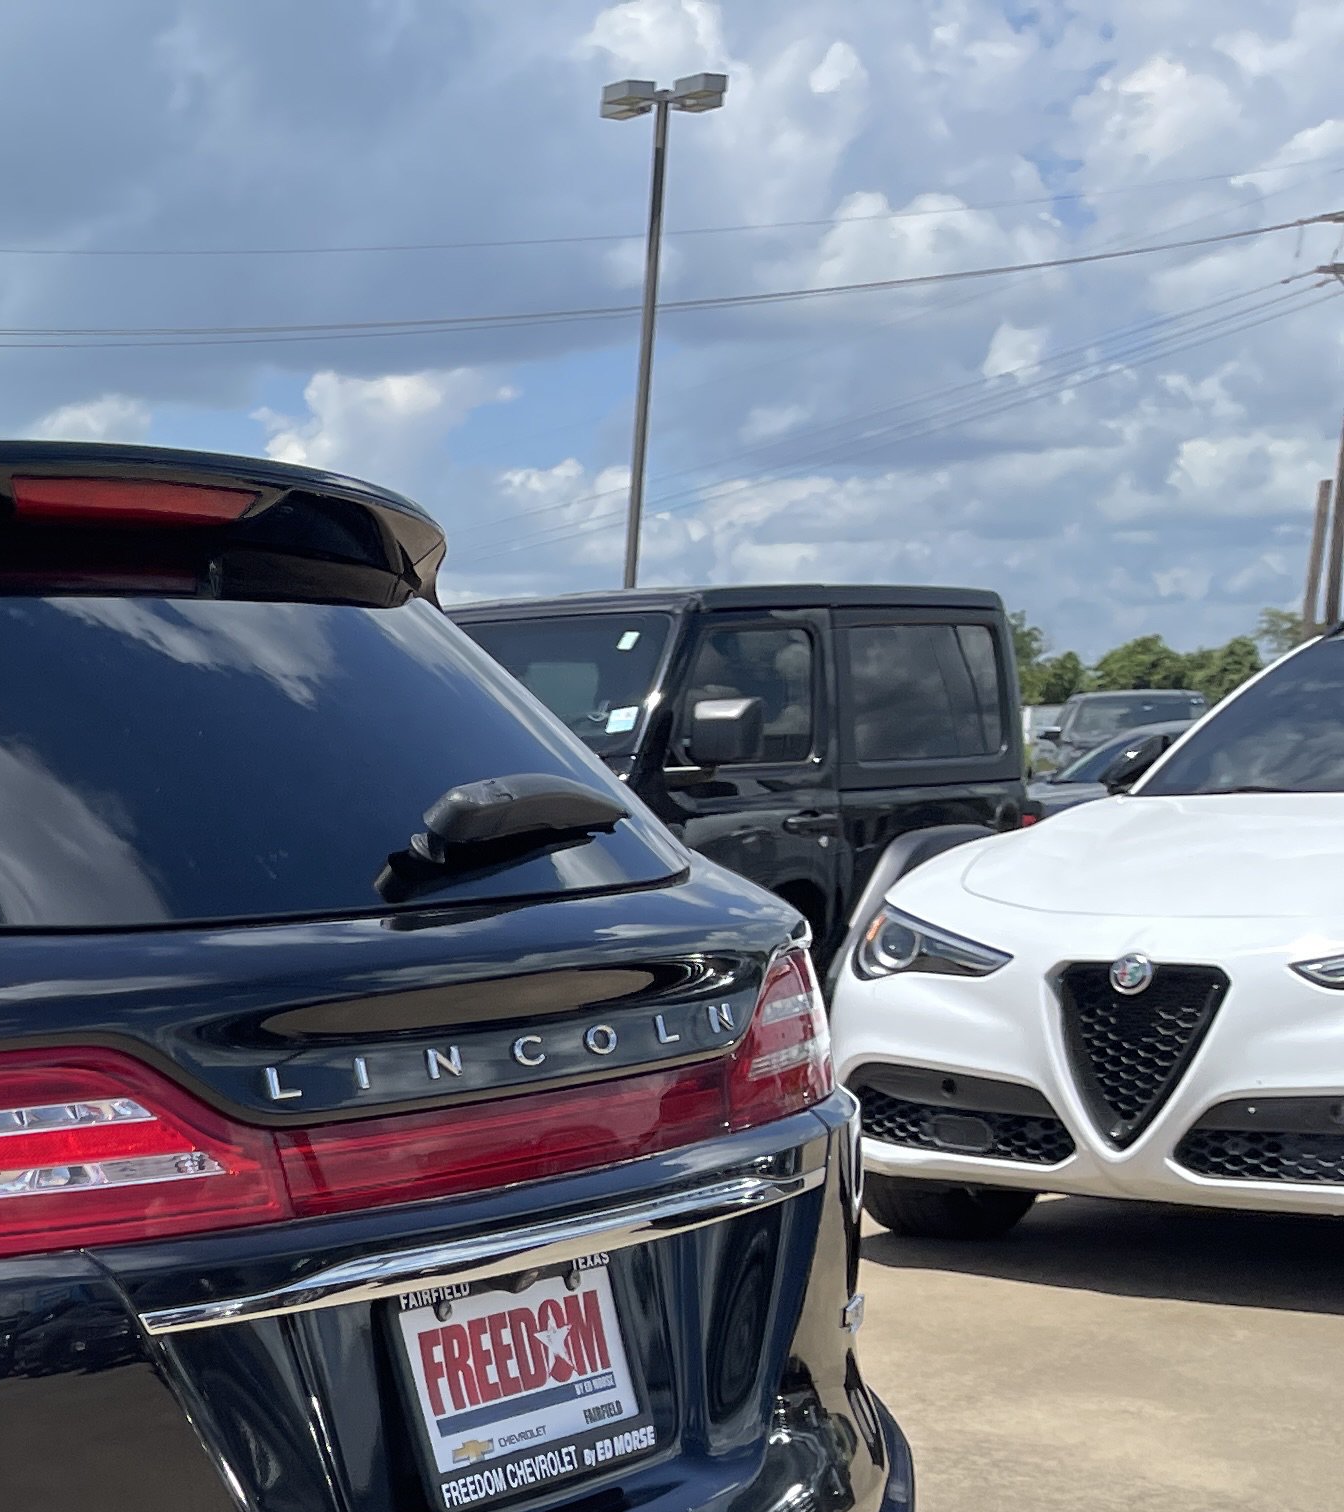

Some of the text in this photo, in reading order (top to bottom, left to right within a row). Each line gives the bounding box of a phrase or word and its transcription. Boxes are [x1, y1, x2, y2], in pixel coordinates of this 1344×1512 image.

[262, 1002, 735, 1101] LINCOLN
[399, 1252, 611, 1310] FAIRFIELD TEXAS
[417, 1289, 613, 1418] FREEDOM
[498, 1425, 547, 1448] CHEVROLET
[582, 1399, 624, 1425] FAIRFIELD
[441, 1467, 507, 1509] FREEDOM
[506, 1445, 579, 1489] CHEVROLET
[595, 1437, 614, 1462] ED
[613, 1425, 656, 1457] MORSE
